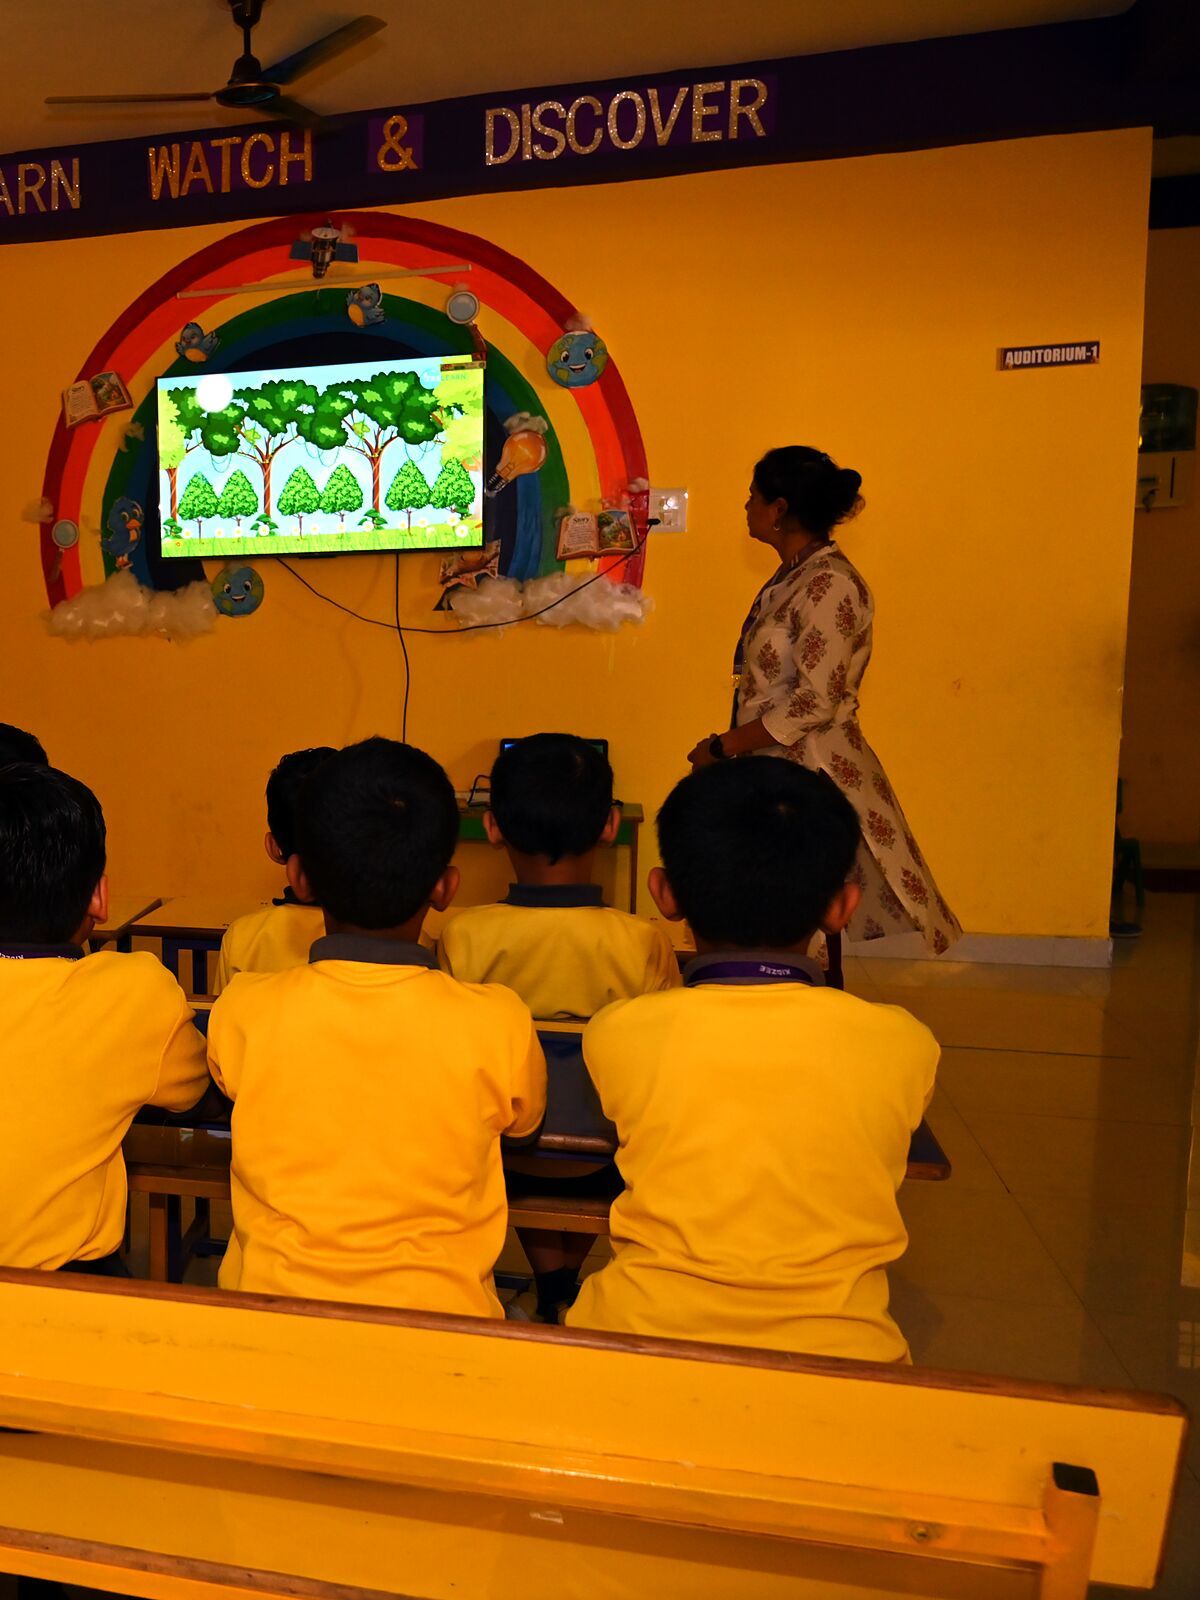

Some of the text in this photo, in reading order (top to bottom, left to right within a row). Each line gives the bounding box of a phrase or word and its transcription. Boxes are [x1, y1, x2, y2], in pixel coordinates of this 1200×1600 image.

[148, 129, 313, 201] WATCH
[376, 115, 419, 172] &
[485, 76, 767, 166] DISCOVER
[1005, 344, 1098, 366] AUDITORIUM-1
